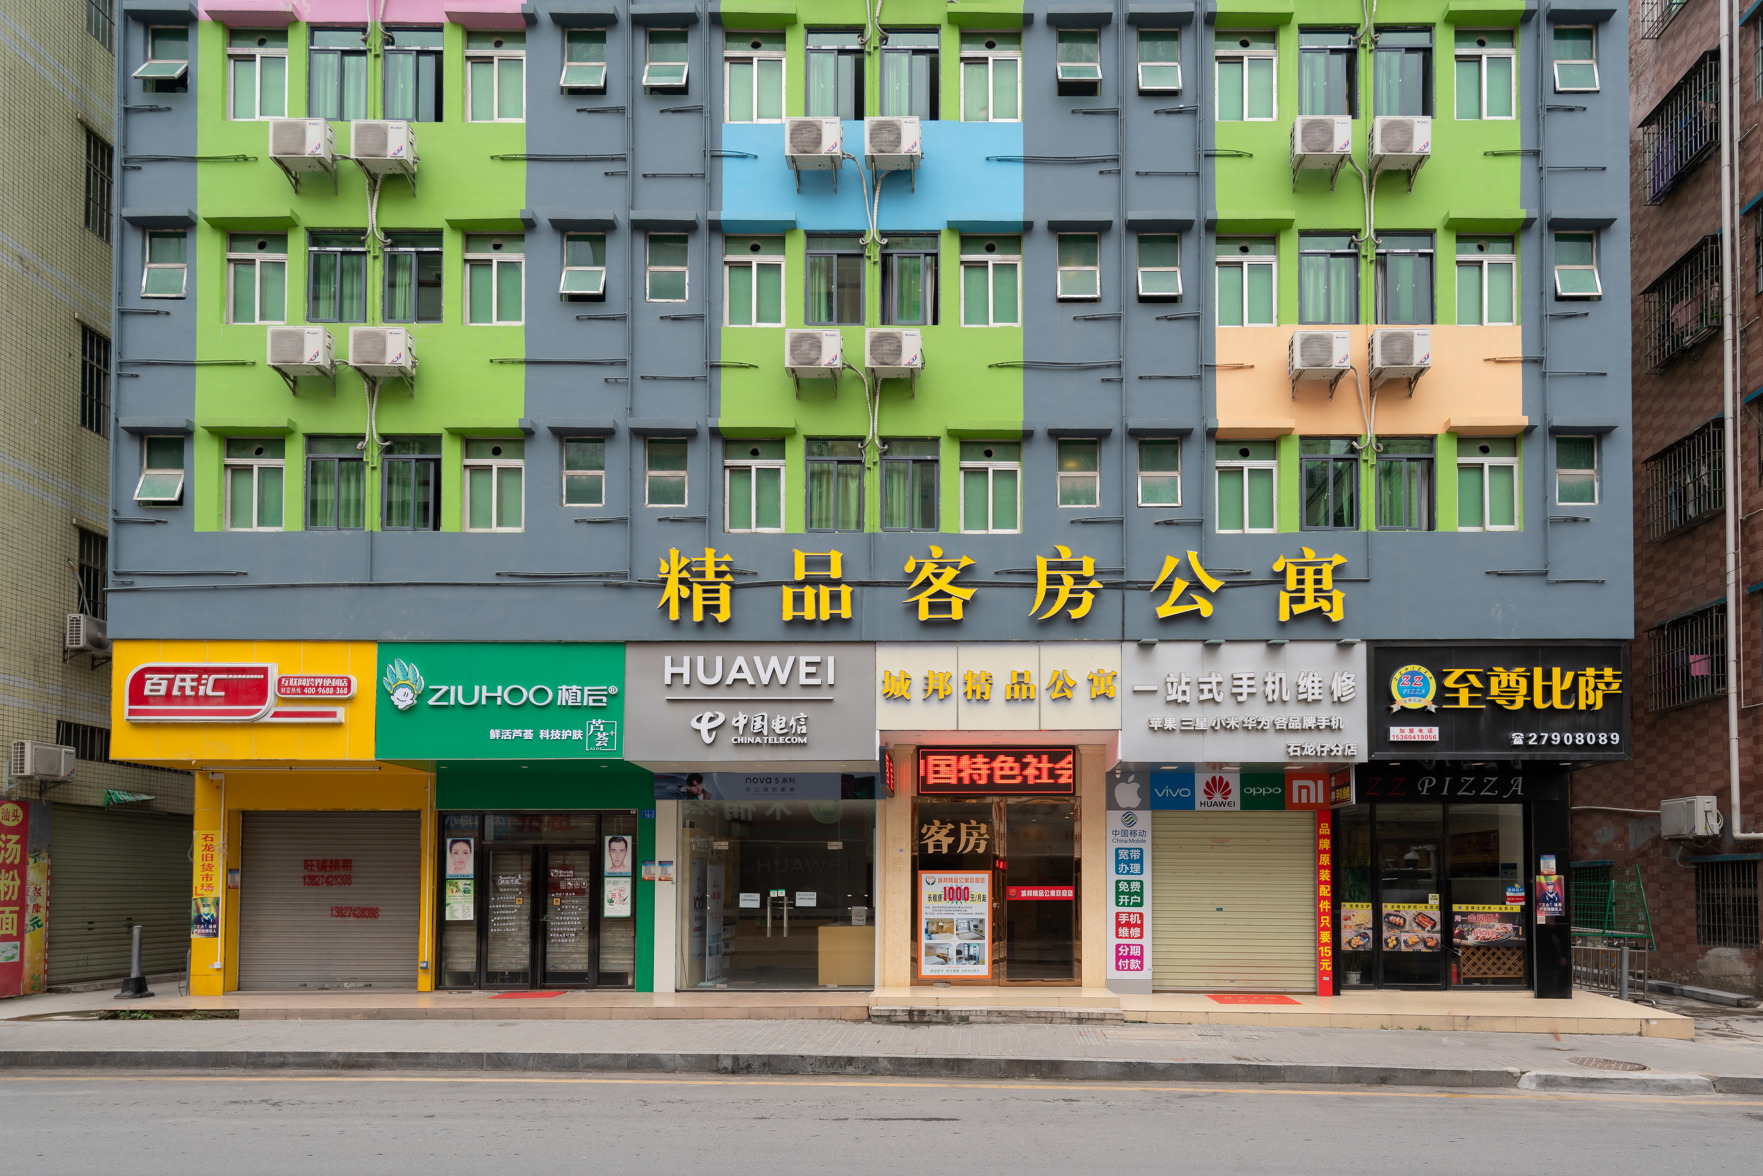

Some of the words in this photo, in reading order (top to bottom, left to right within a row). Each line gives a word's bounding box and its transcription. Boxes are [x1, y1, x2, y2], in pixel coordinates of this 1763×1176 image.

[658, 545, 1348, 624] 精品客房公寓
[664, 656, 835, 685] HUAWEI
[143, 674, 228, 697] 百氏汇
[280, 678, 348, 687] 互联网跨界便利店
[881, 669, 1118, 701] 城邦精品公寓
[1132, 671, 1357, 703] 一站式手机维修
[1442, 667, 1622, 710] 至尊比萨
[427, 684, 553, 706] ZIUHOO
[731, 711, 808, 736] 中国电信
[1148, 716, 1177, 731] 苹果
[1180, 716, 1209, 731] 三星
[1212, 716, 1240, 731] 小米
[1242, 716, 1270, 731] 华为
[1274, 716, 1345, 731] 各品牌手机
[489, 729, 534, 741] 鲜活芦荟
[539, 729, 583, 741] 科技护肤
[731, 736, 761, 744] CHINA
[762, 736, 808, 744] TELECOM
[1528, 732, 1620, 745] 27908089
[1286, 743, 1358, 757] 石龙仔分店
[745, 776, 772, 784] nova
[1155, 786, 1191, 797] vivo
[1243, 787, 1282, 796] oppo
[1365, 777, 1406, 796] ZZ
[1417, 776, 1525, 798] PIZZA
[1, 807, 21, 822] 汕头
[920, 819, 991, 854] 客房
[1112, 829, 1146, 838] 中国移动
[1118, 849, 1141, 860] 宽带
[200, 833, 215, 892] 石龙旧货市场
[1118, 863, 1141, 874] 办理
[1118, 881, 1141, 892] 免费
[1118, 895, 1141, 906] 开户
[1318, 823, 1332, 971] 品牌原装配件只要15元
[1118, 913, 1141, 924] 手机
[1118, 927, 1141, 938] 维修
[1118, 945, 1141, 957] 分期
[1118, 959, 1141, 970] 付款
